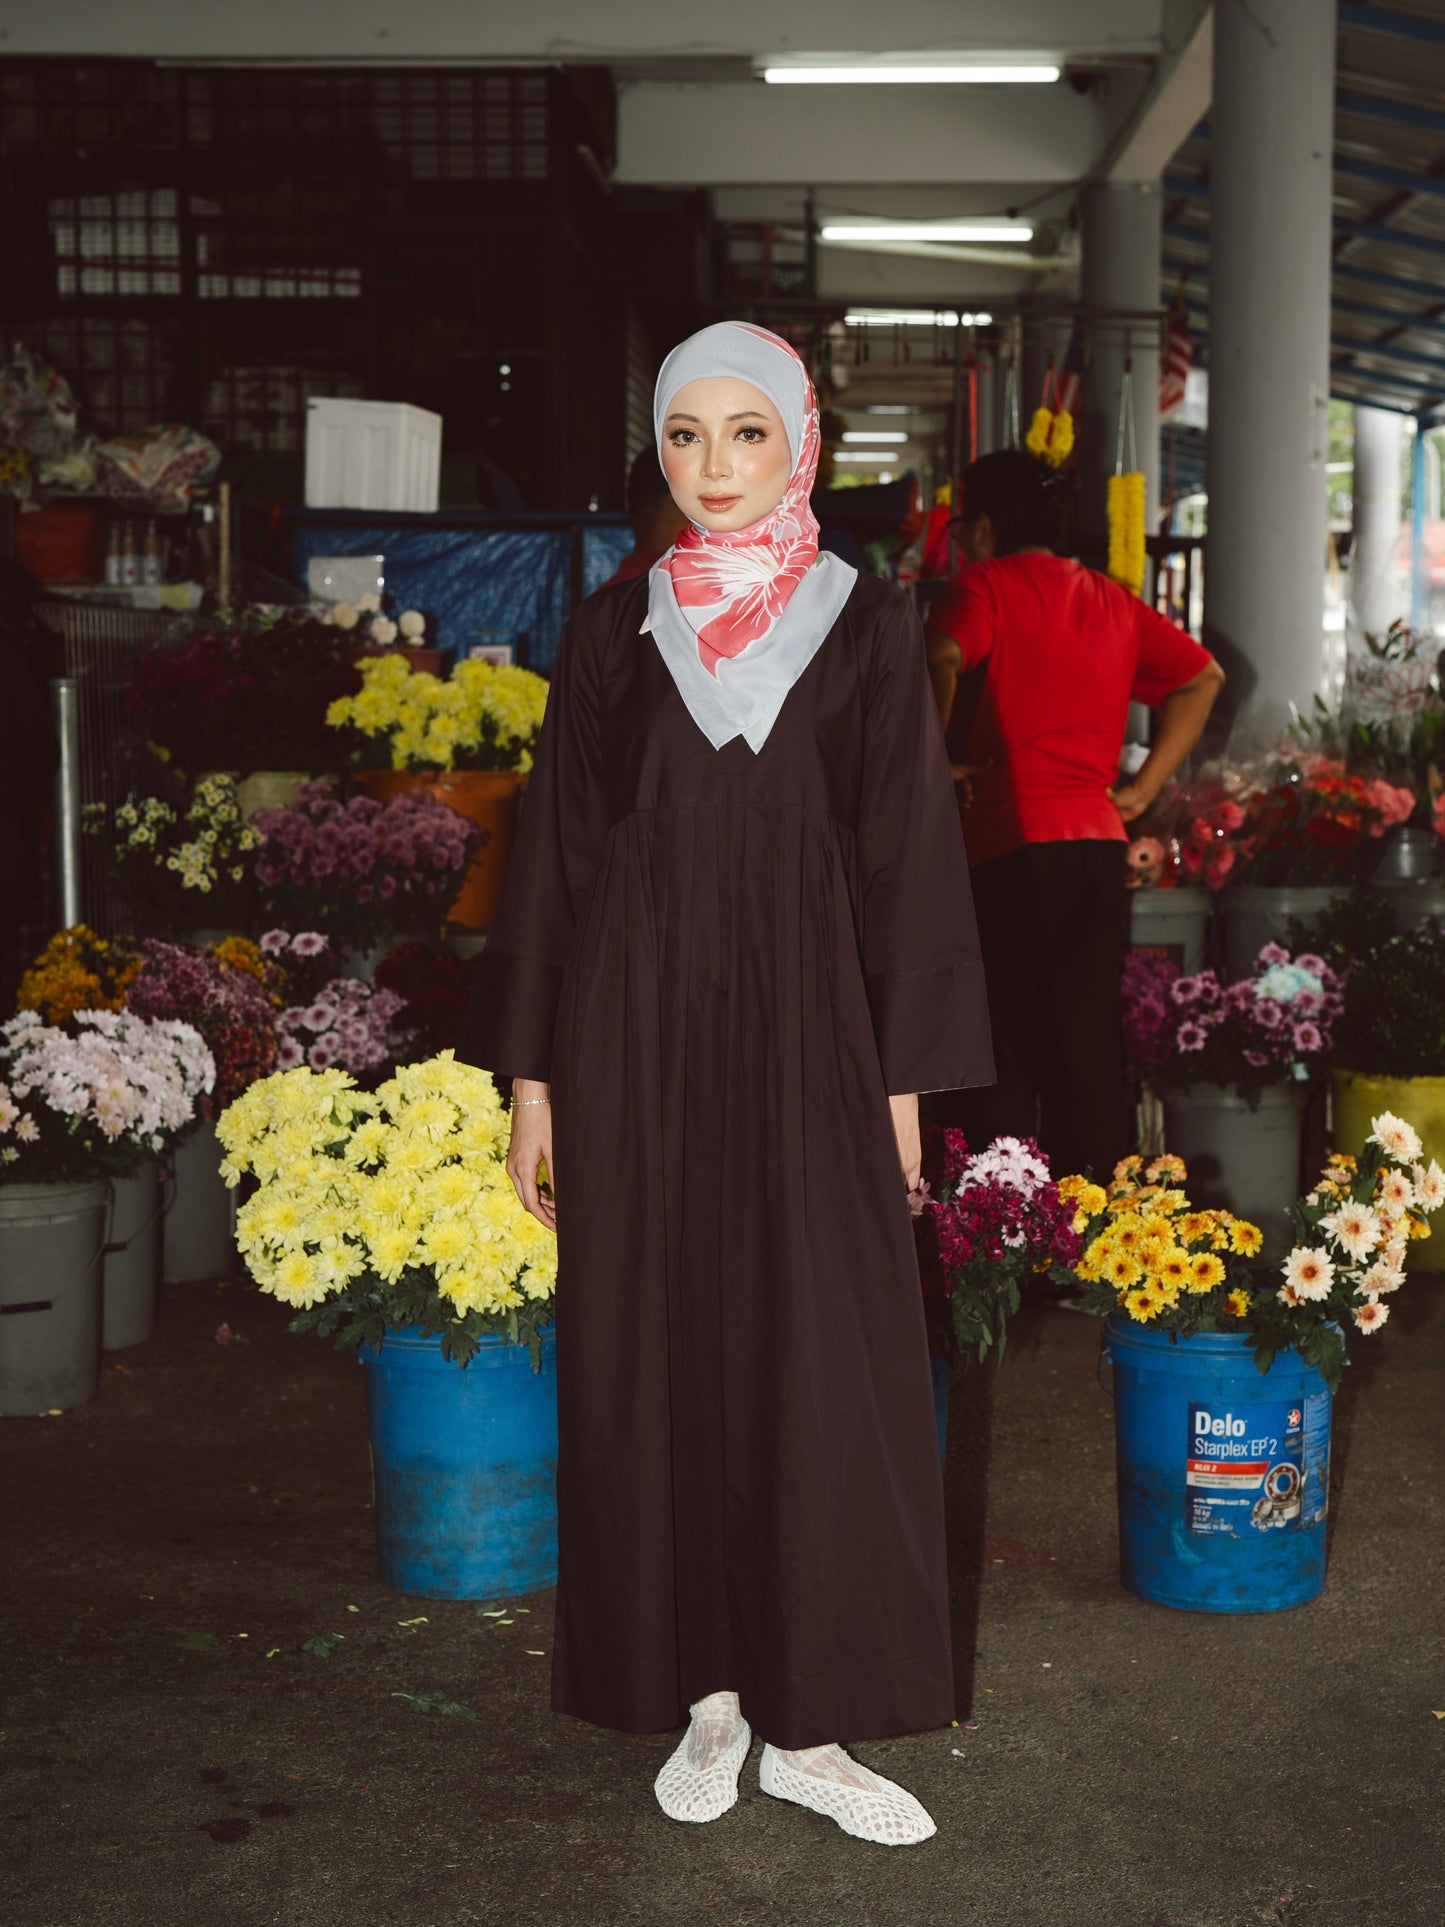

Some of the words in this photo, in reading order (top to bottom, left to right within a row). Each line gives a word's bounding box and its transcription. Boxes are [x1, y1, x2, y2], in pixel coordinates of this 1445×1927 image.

[1195, 1411, 1246, 1437] Delo
[1195, 1438, 1248, 1459] Starplex
[1251, 1439, 1268, 1456] EP
[1269, 1439, 1277, 1455] 2
